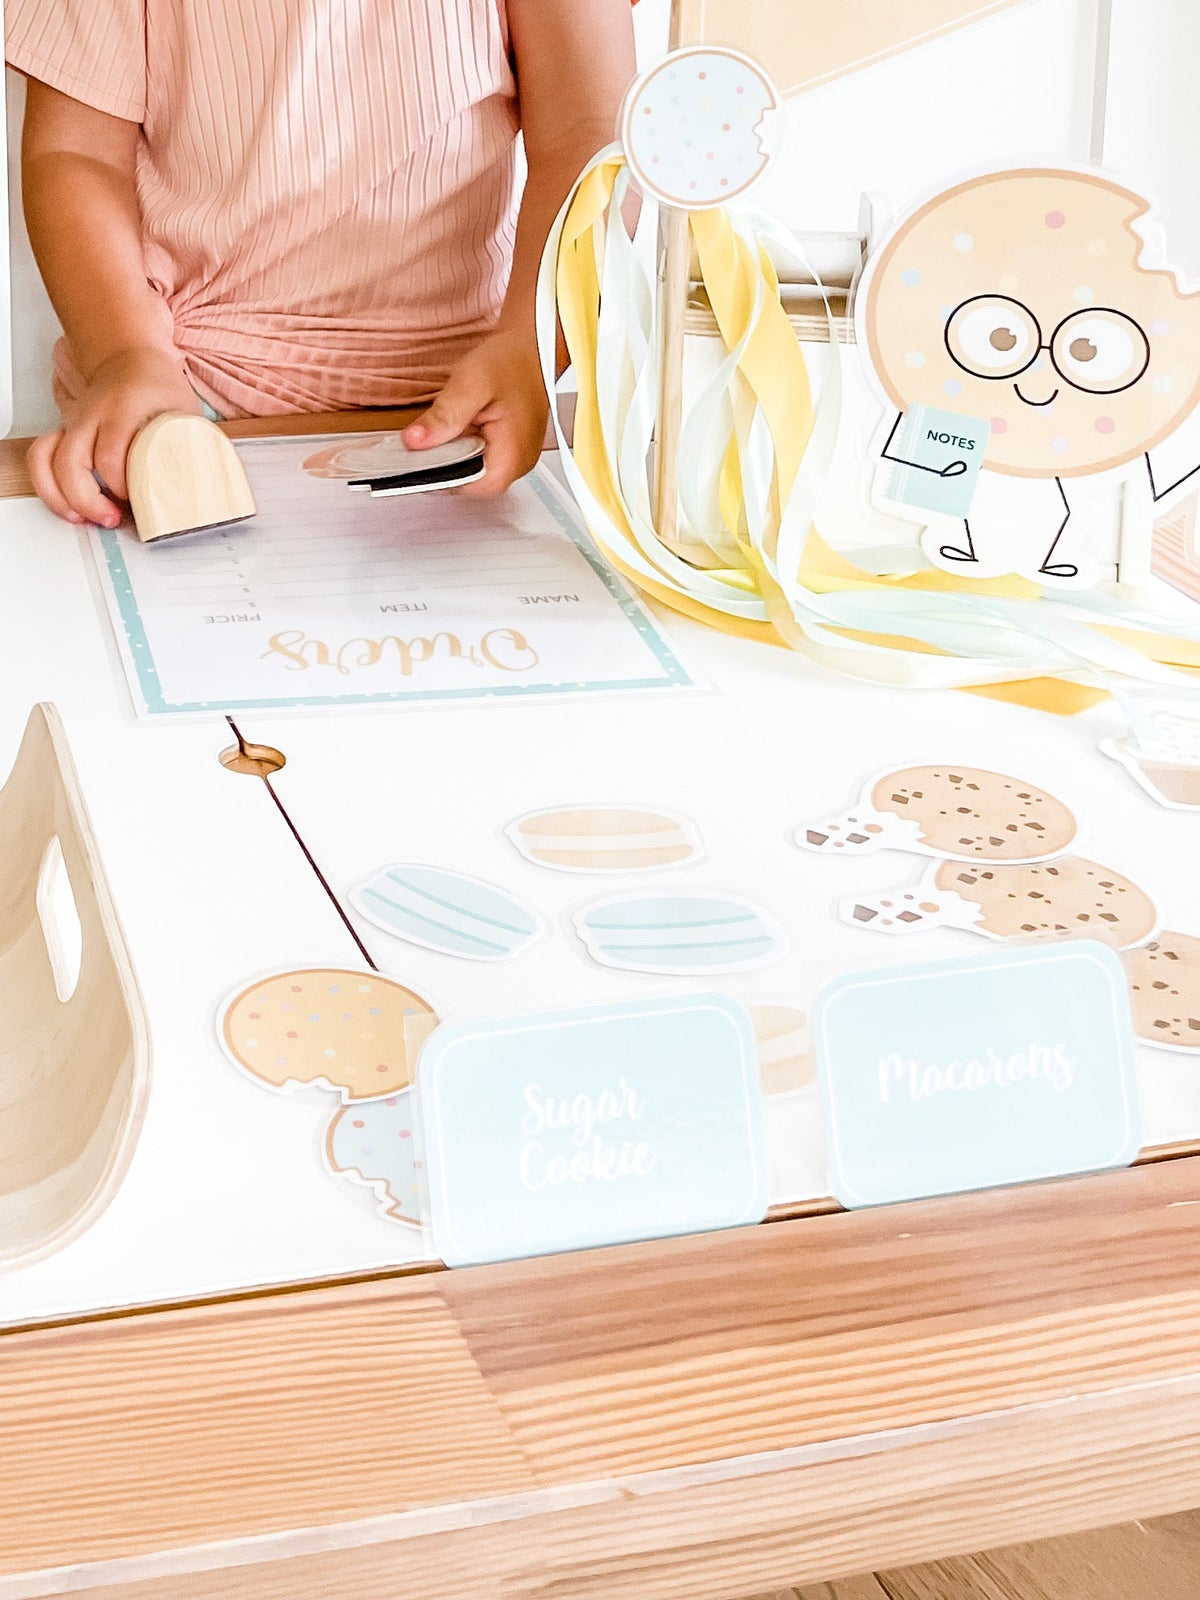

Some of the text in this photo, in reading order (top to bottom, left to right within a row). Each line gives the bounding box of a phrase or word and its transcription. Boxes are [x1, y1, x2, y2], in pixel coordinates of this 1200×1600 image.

[928, 429, 976, 450] NOTES
[204, 592, 578, 624] NAME ITEM PRICE
[261, 628, 539, 676] Orders
[877, 1038, 1078, 1106] Macarons
[521, 1077, 645, 1144] Sugar
[519, 1138, 656, 1191] Cookie
